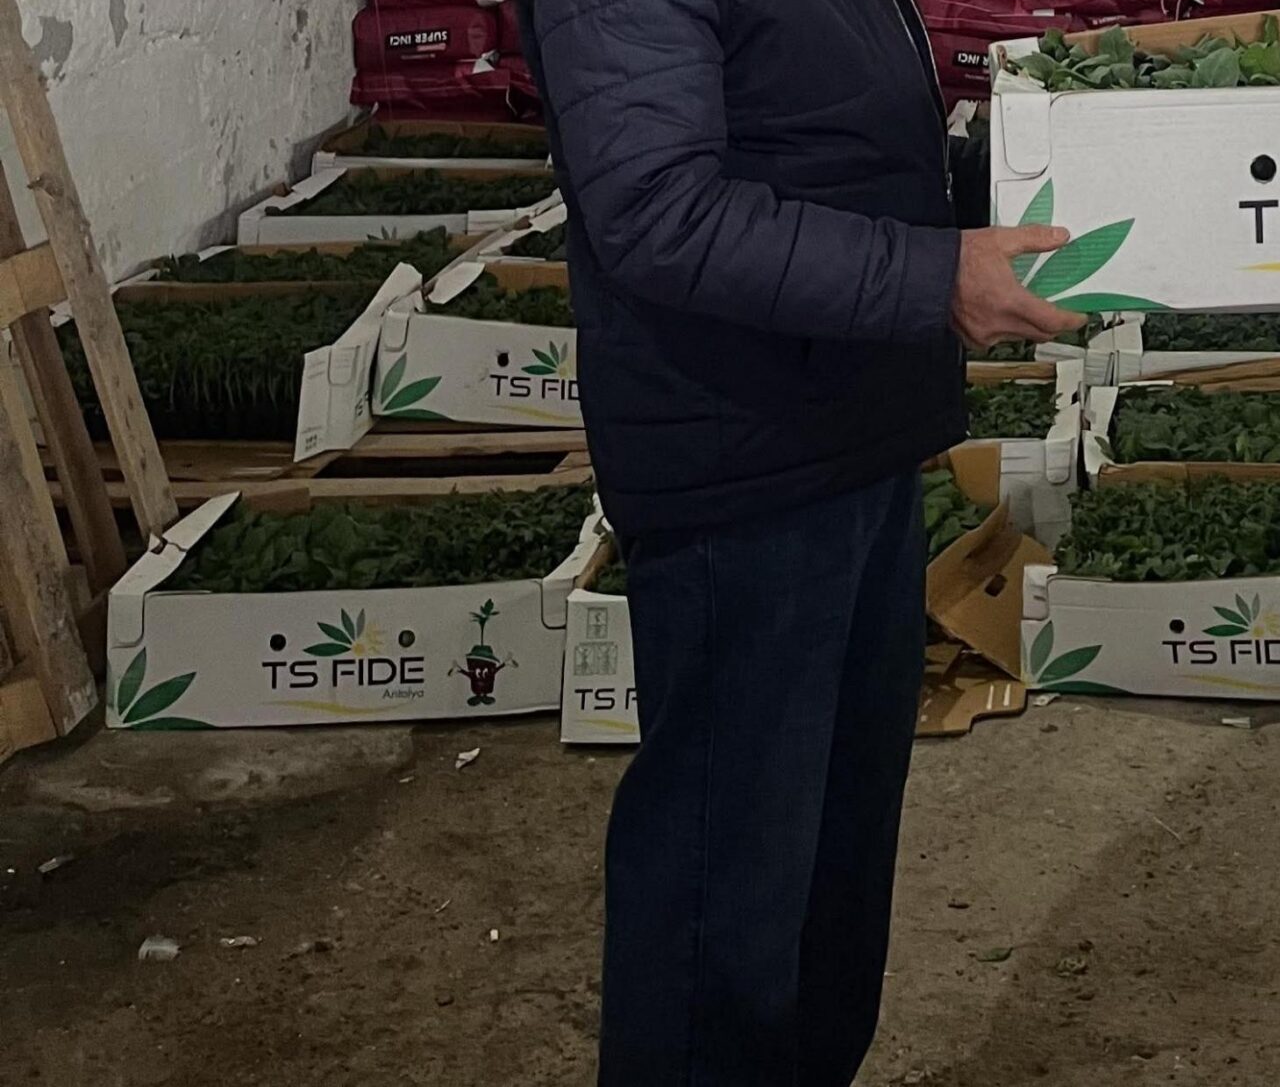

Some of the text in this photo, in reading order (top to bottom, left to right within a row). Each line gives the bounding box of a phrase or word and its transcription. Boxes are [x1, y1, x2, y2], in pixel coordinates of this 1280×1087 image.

[389, 30, 447, 46] SUPER INCI
[958, 53, 980, 65] INCI
[489, 374, 581, 401] TS FID
[1161, 640, 1218, 665] TS
[261, 656, 425, 689] TS FIDE
[382, 686, 425, 701] Antalya
[574, 687, 615, 711] TS
